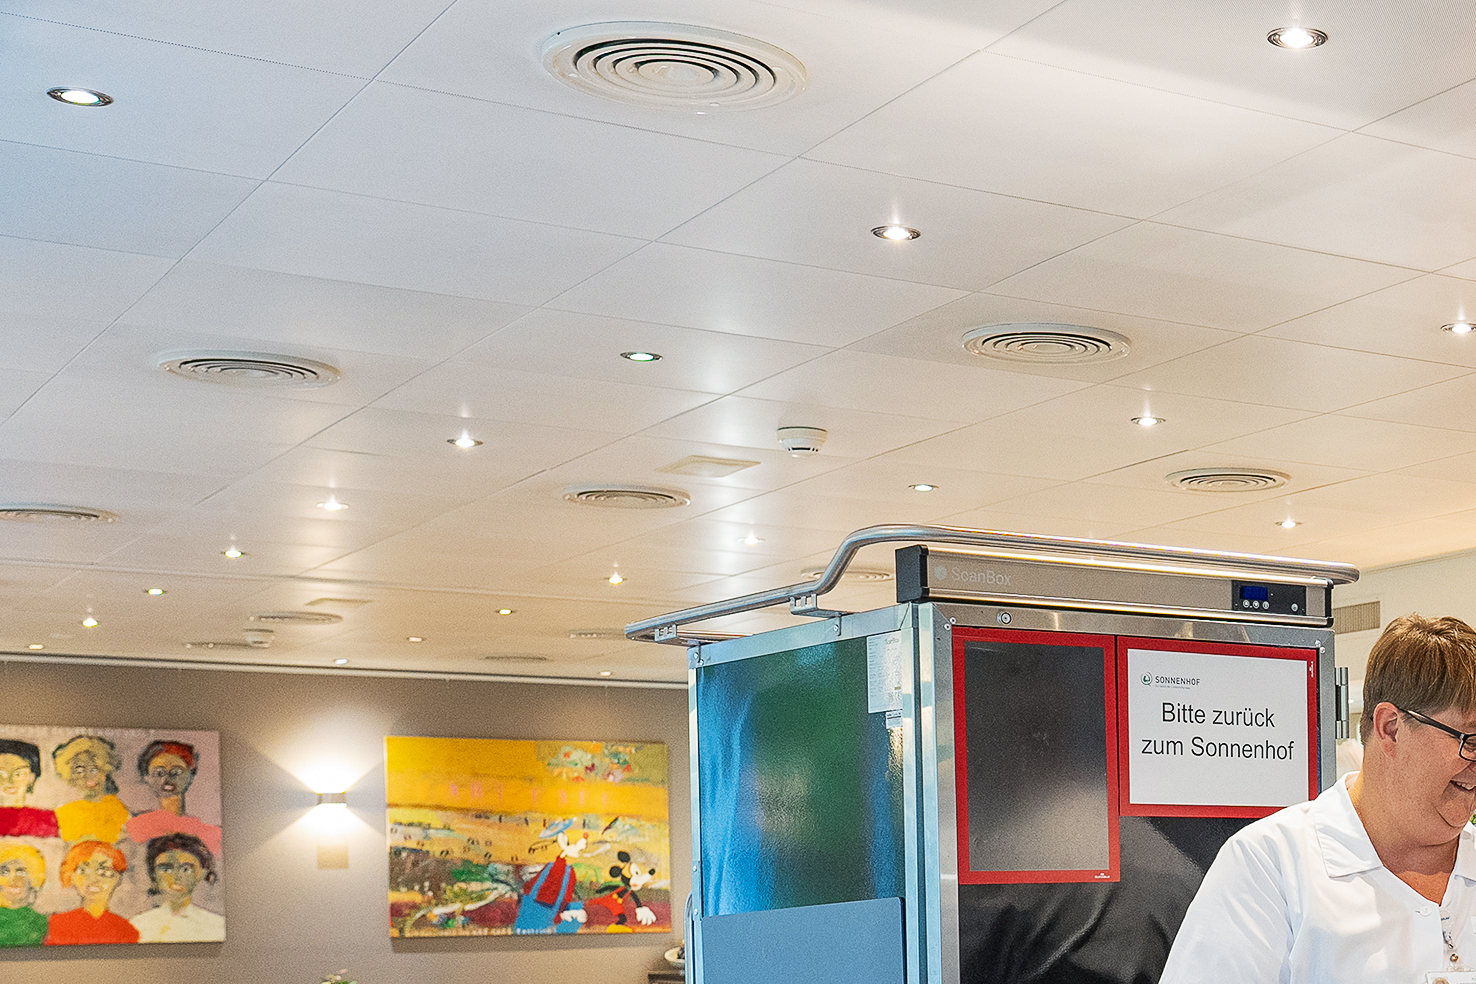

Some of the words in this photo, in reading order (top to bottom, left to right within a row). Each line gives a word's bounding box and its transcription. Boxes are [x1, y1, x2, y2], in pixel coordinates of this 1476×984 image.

[951, 567, 1012, 586] ScanBox
[1155, 675, 1201, 686] SONNENHOF
[1162, 702, 1206, 724] Bitte
[1212, 707, 1276, 728] zurück
[1141, 738, 1184, 756] zum
[1191, 736, 1295, 760] Sonnenhof
